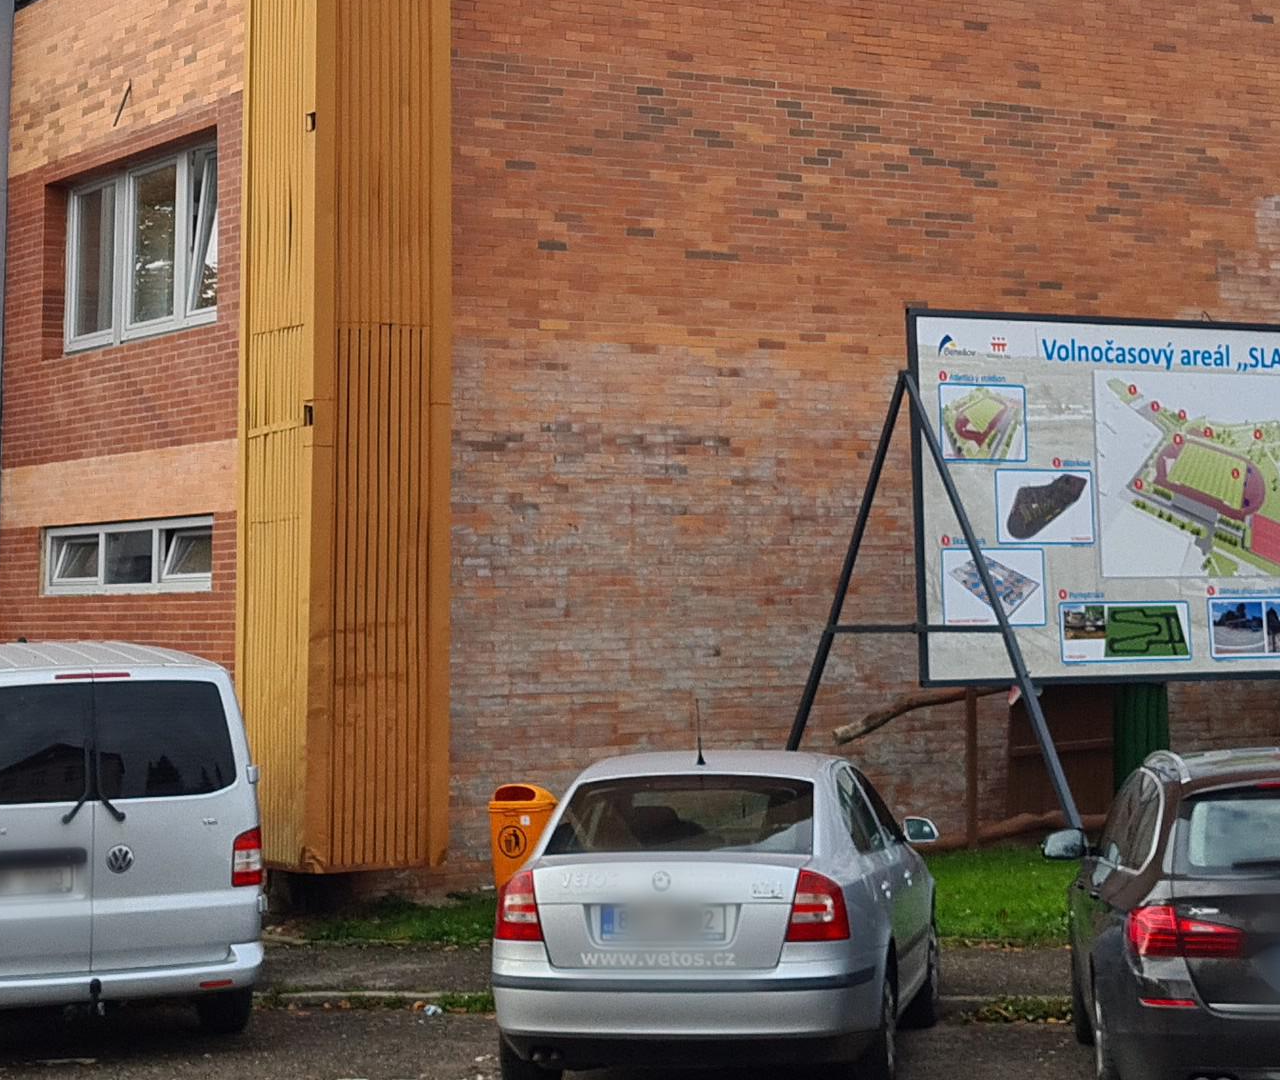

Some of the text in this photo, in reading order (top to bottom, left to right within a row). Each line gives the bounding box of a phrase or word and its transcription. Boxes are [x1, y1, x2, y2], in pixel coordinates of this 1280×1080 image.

[1041, 338, 1174, 369] Volnočasový
[1180, 344, 1230, 367] areál
[580, 950, 736, 968] www.vetos.cz
